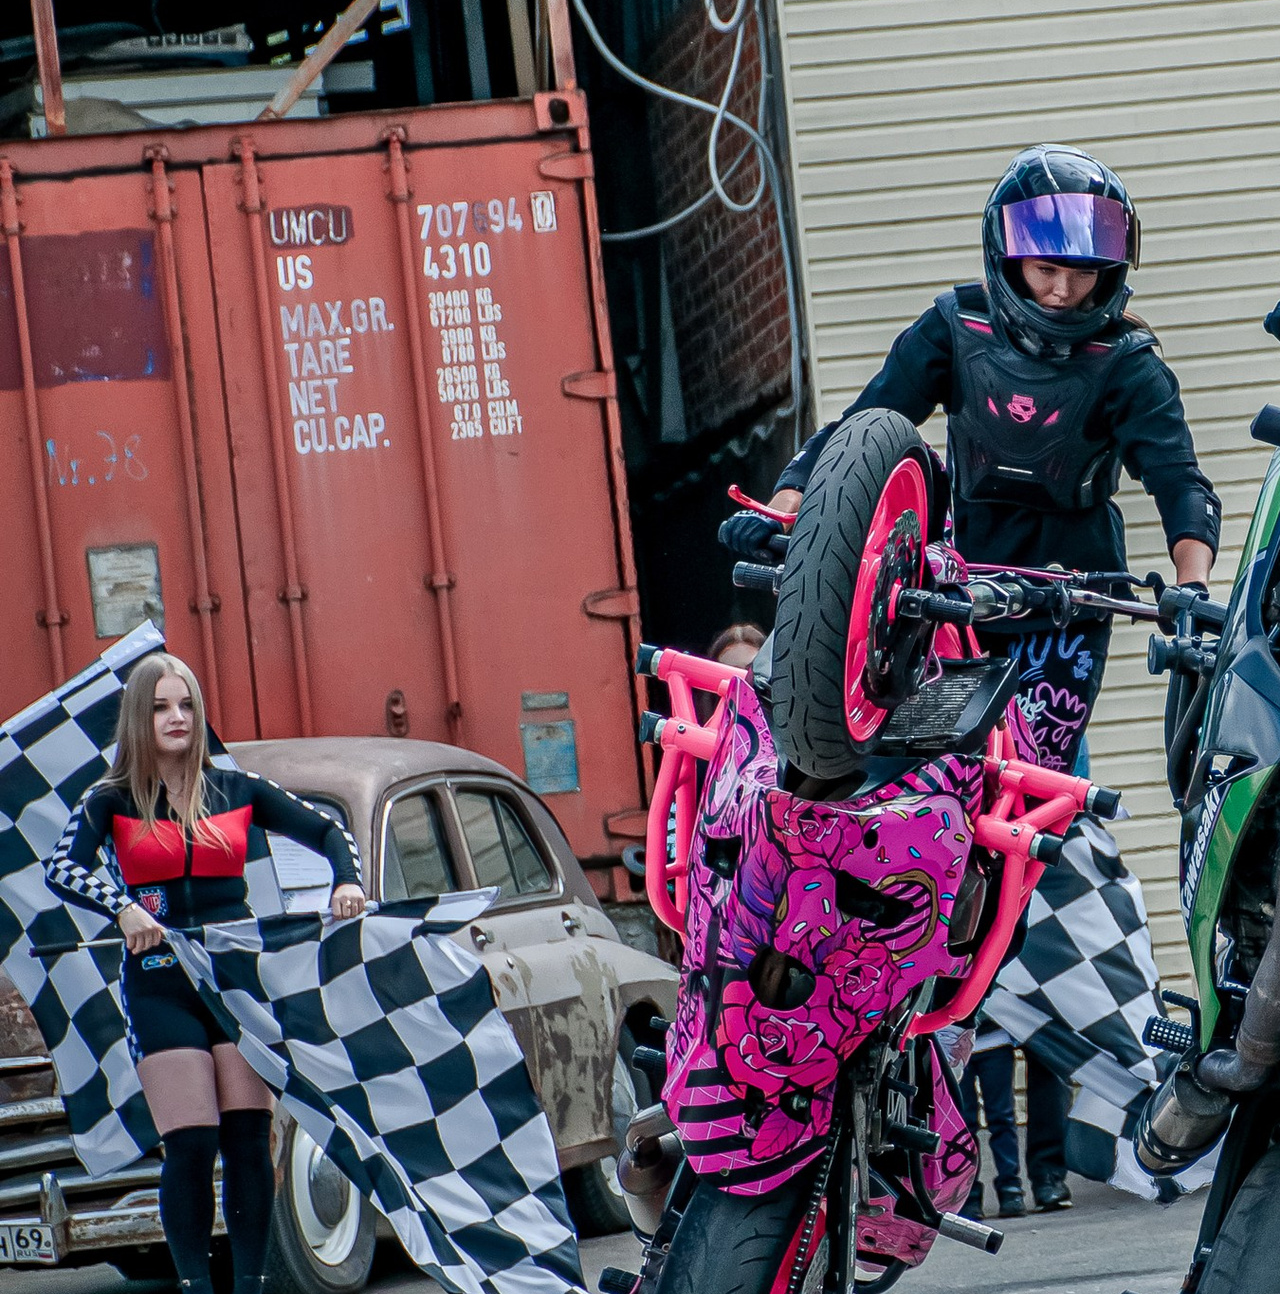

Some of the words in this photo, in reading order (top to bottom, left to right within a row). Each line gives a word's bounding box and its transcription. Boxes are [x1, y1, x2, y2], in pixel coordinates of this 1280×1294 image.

[276, 254, 314, 291] US
[423, 242, 492, 280] 4310
[279, 296, 395, 340] MAX.GR.
[284, 337, 354, 378] TARE
[288, 377, 338, 417] NET
[293, 412, 391, 455] CU.CAP.
[16, 1228, 42, 1249] 69
[16, 1249, 38, 1257] RUS
